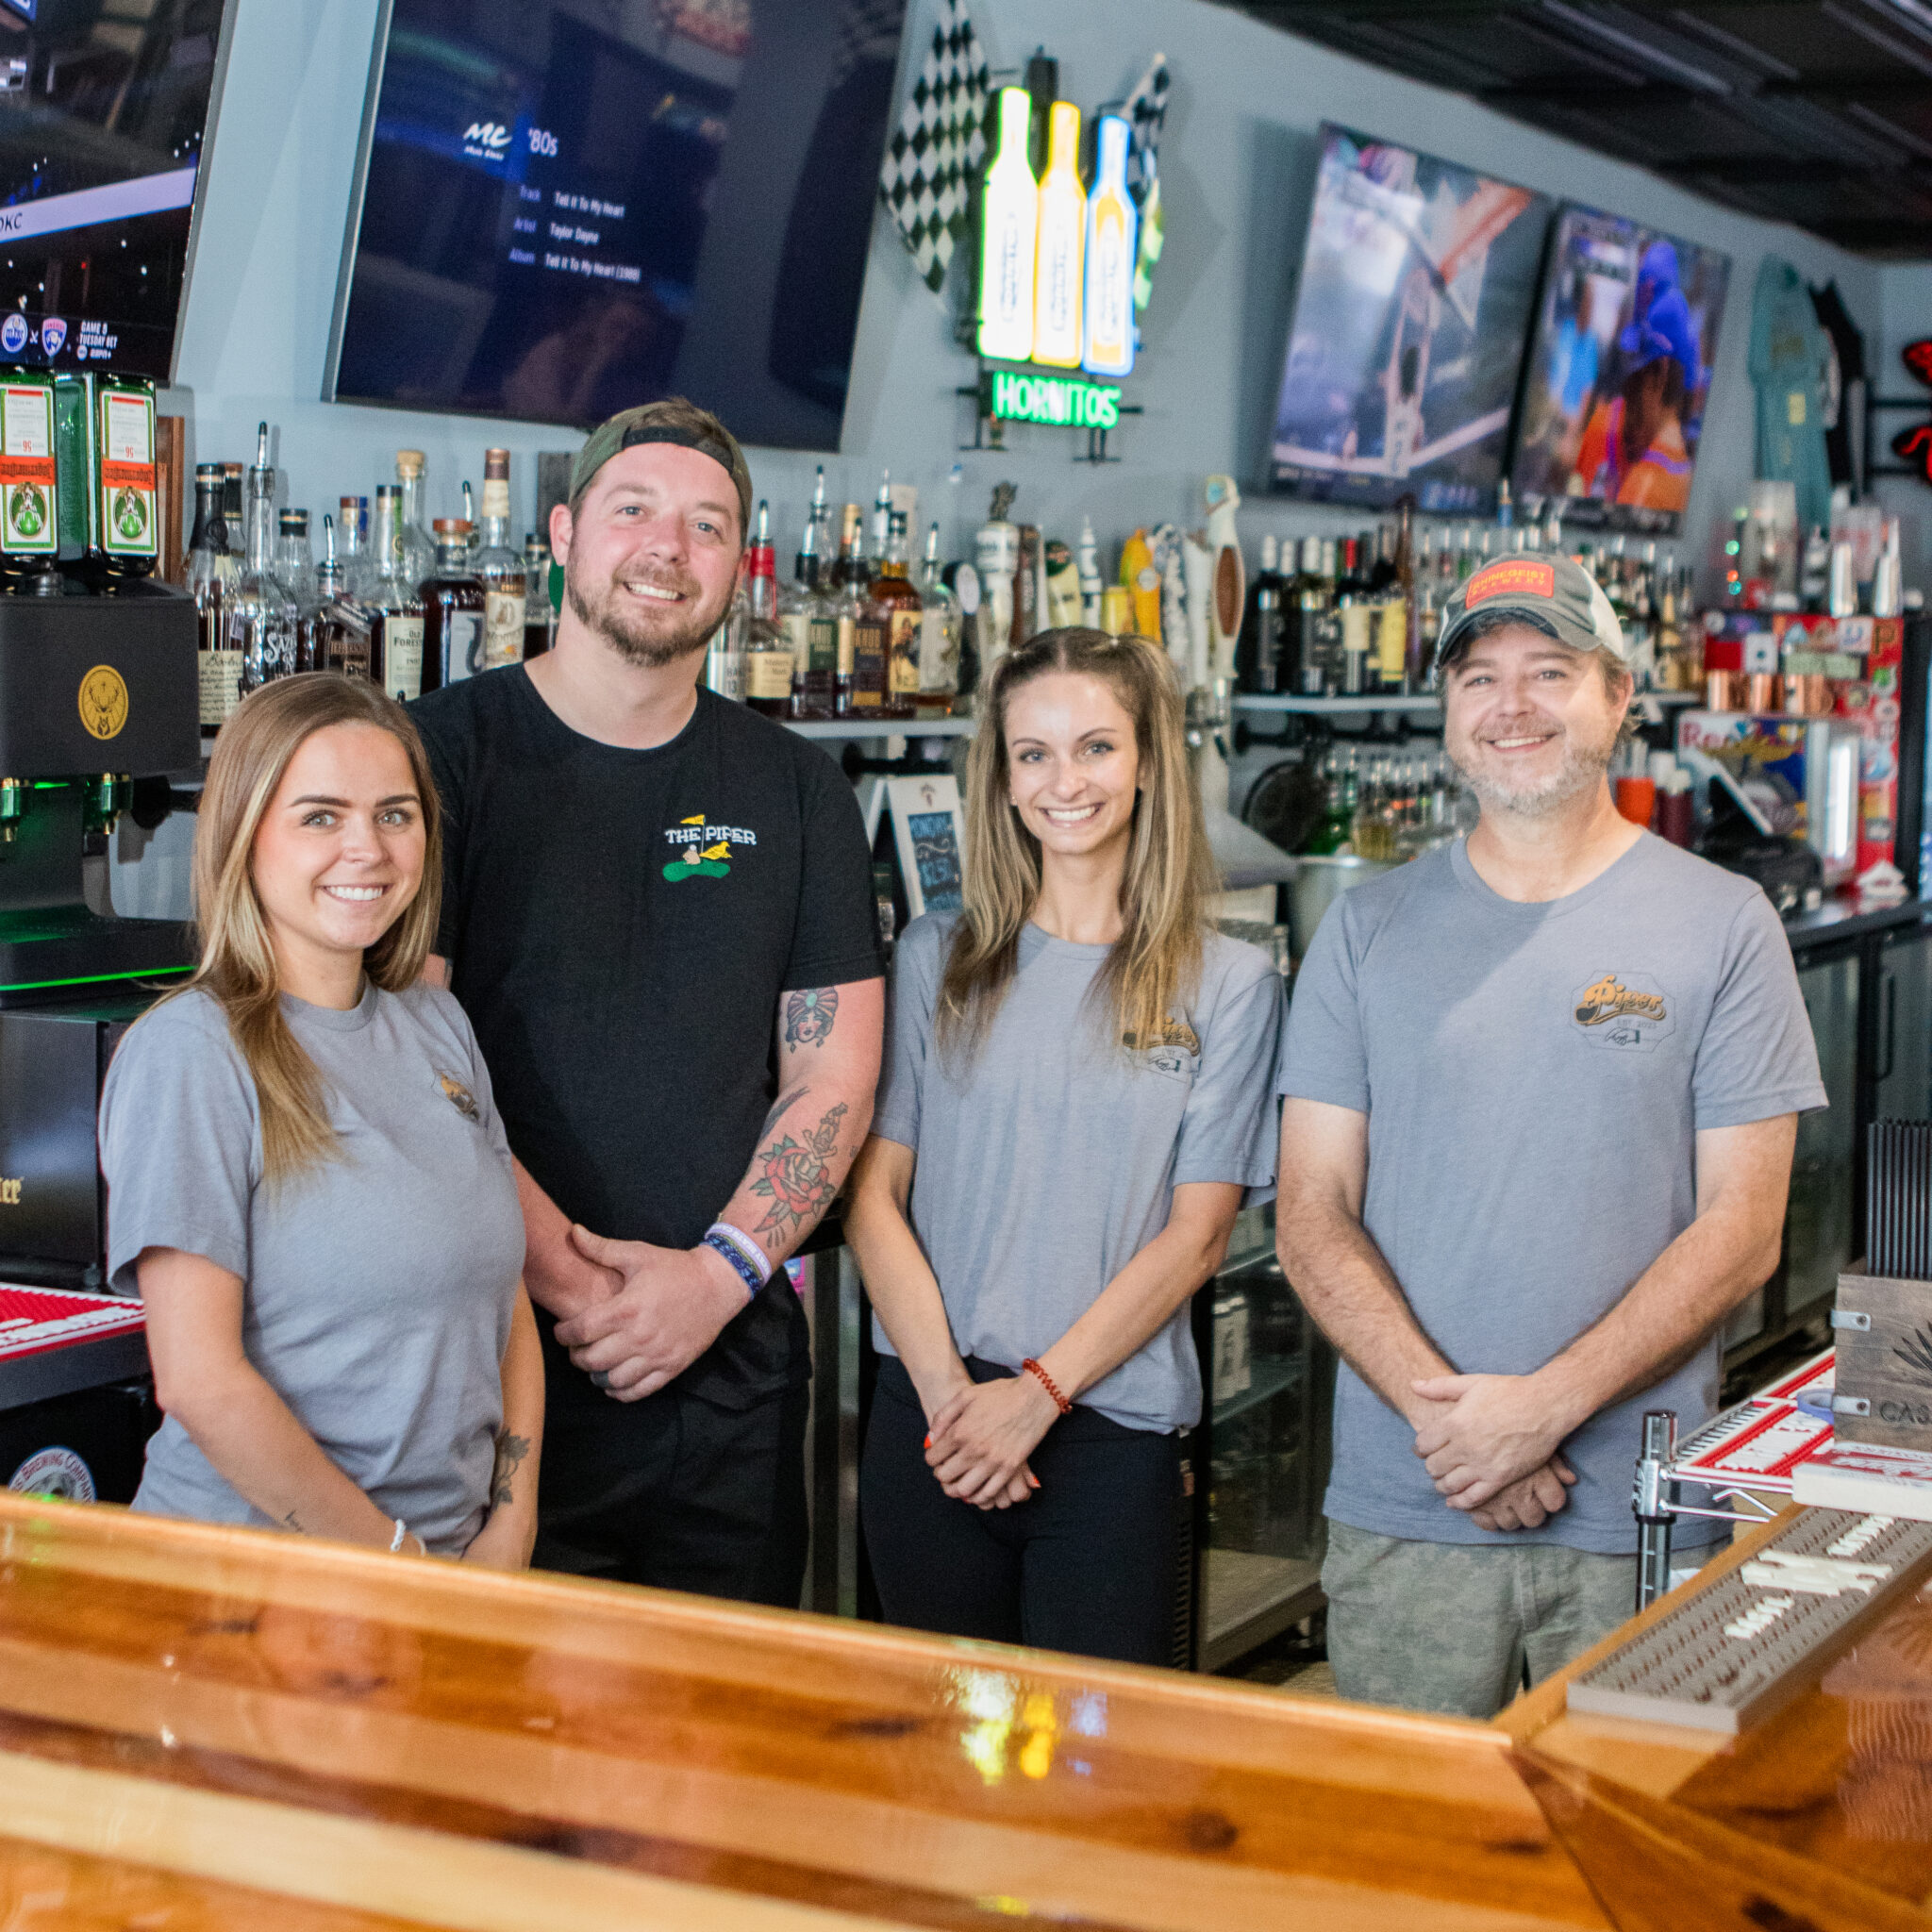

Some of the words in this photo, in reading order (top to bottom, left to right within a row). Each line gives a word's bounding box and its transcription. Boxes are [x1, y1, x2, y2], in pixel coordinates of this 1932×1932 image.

[528, 127, 558, 158] '80s
[555, 191, 570, 208] Tell
[571, 195, 578, 209] It
[579, 196, 590, 212] To
[590, 198, 603, 215] My
[603, 202, 626, 219] Heart
[550, 222, 574, 241] Taylor
[545, 253, 560, 270] Tell
[570, 258, 579, 273] To
[580, 260, 592, 277] My
[593, 262, 615, 278] Heart
[79, 333, 106, 347] TUESDAY
[81, 320, 102, 335] GAME
[992, 371, 1122, 429] HORNITOS
[664, 827, 702, 844] THE
[705, 825, 758, 846] PIPER
[21, 1454, 63, 1481] BREWING
